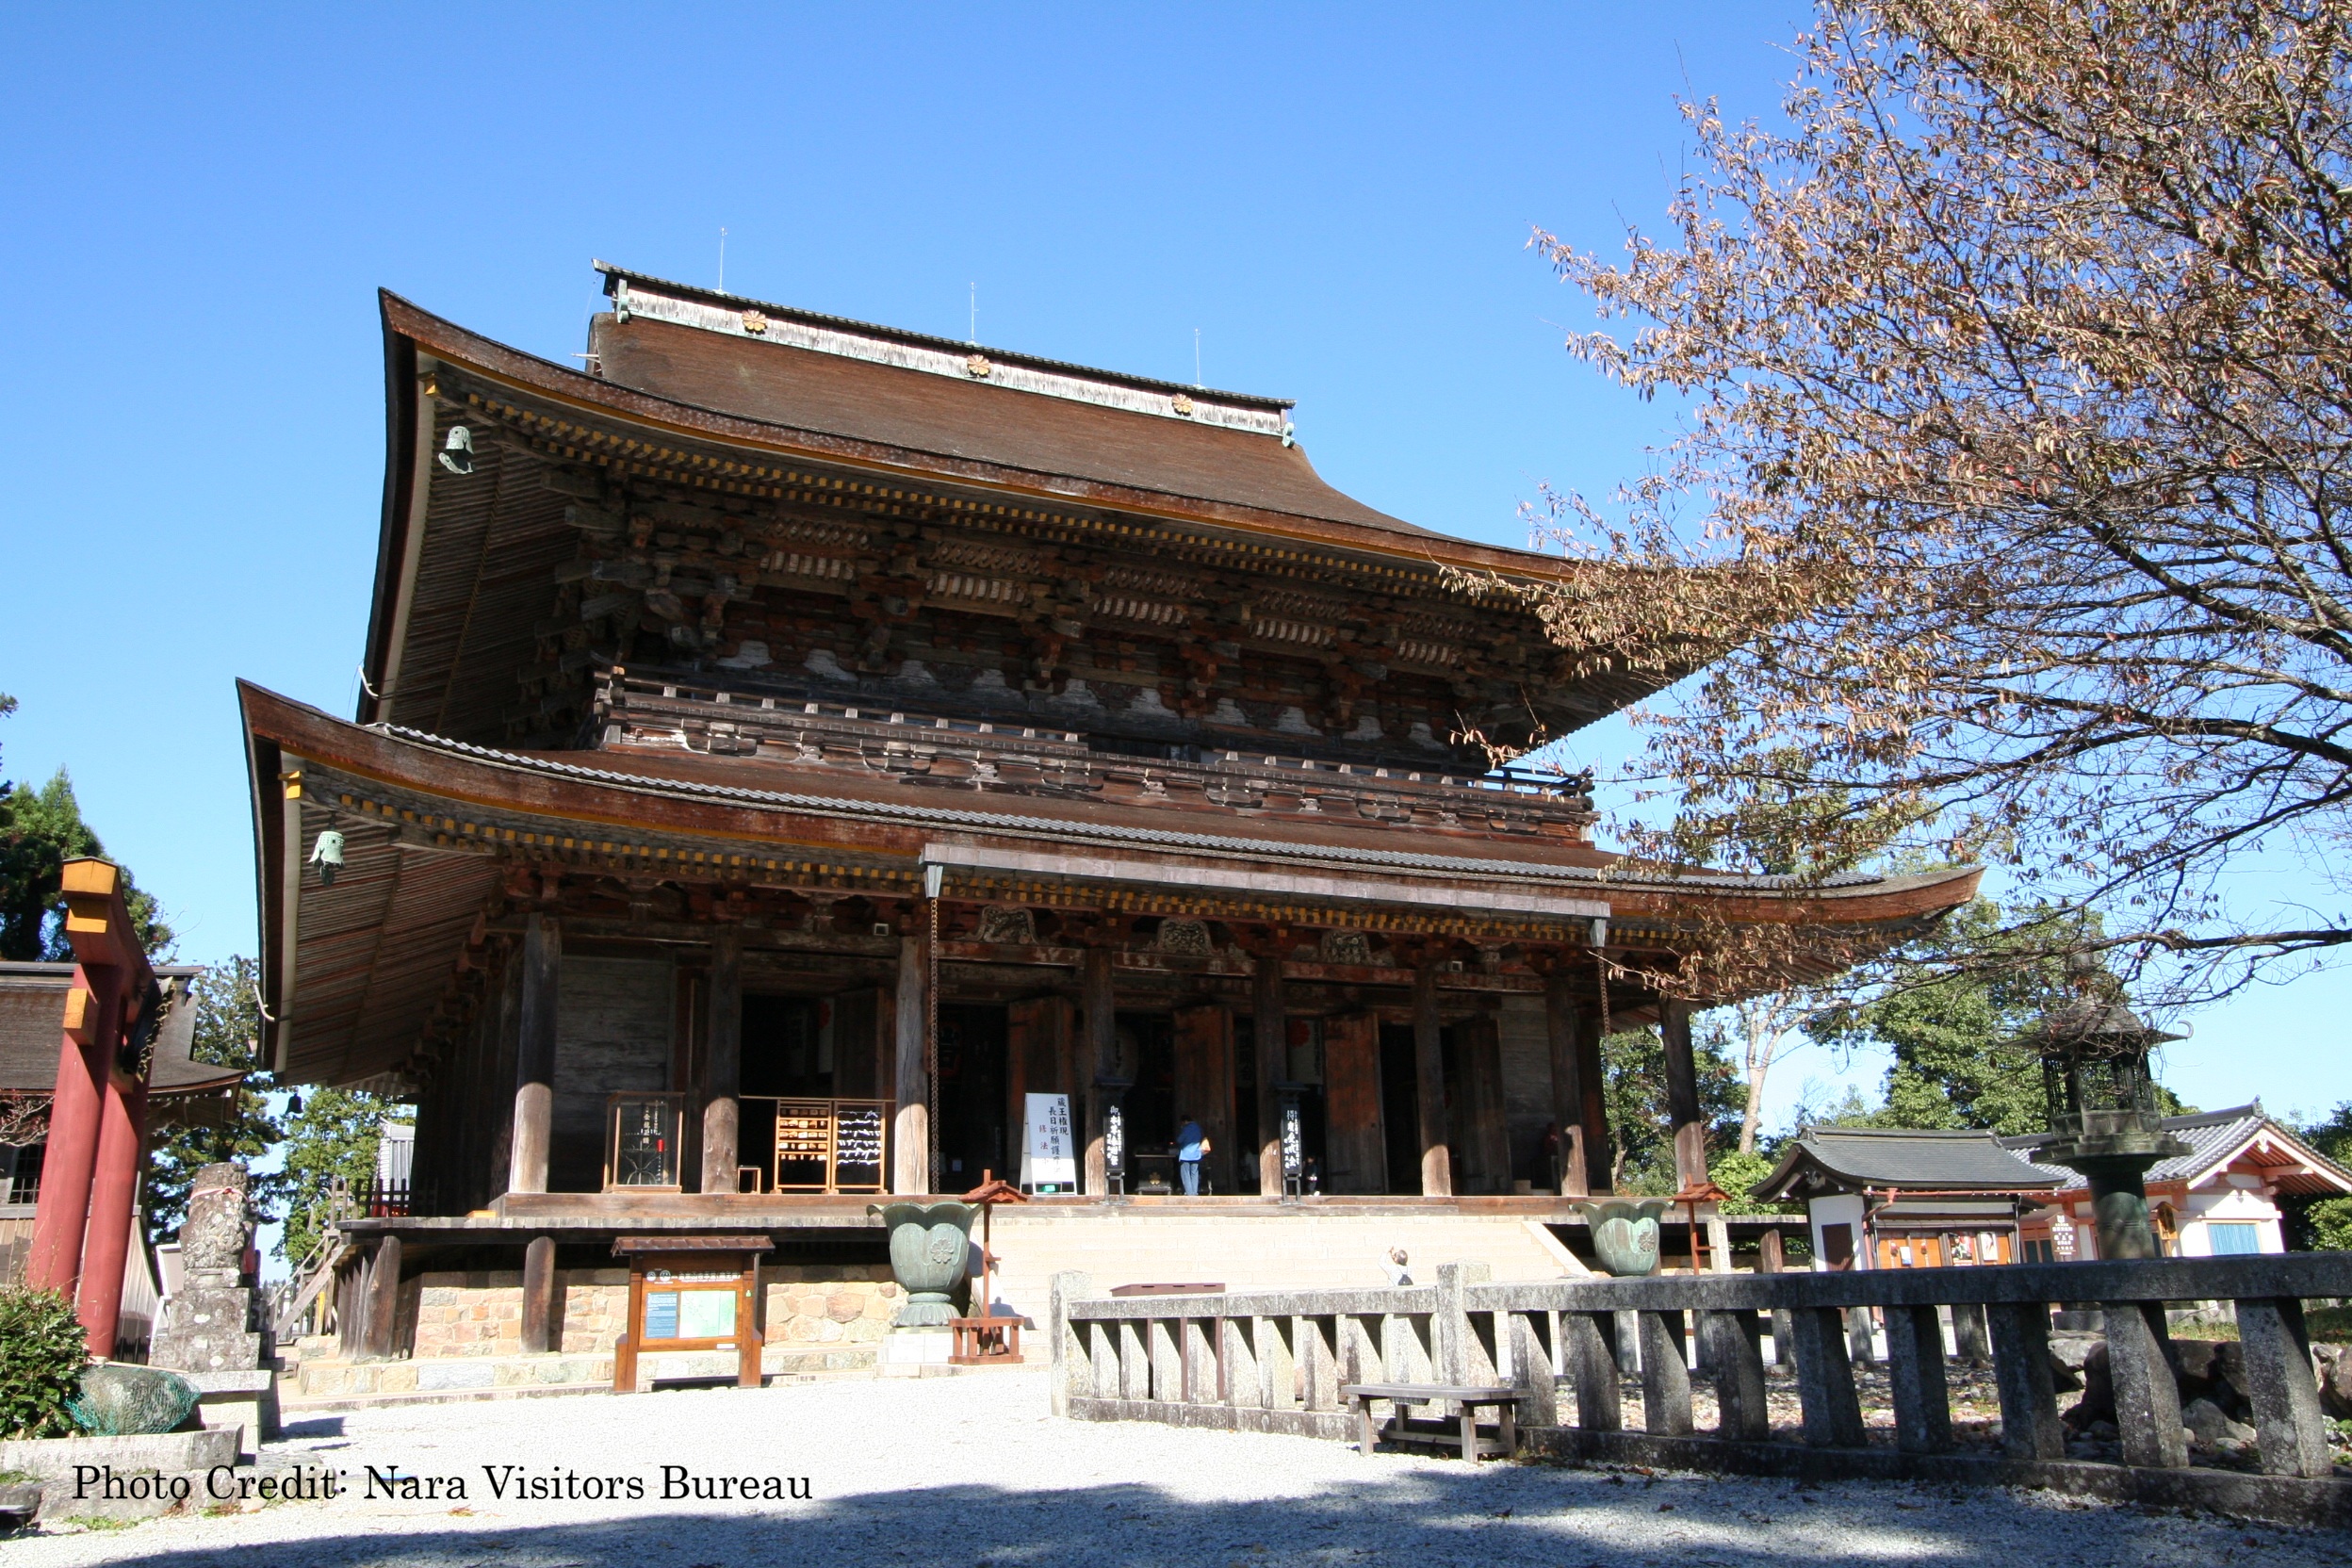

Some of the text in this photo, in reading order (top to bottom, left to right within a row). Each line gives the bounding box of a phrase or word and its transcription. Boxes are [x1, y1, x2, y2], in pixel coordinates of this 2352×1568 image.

[1049, 1106, 1061, 1172] 長日祈願護
[1057, 1097, 1069, 1135] 蔵王権現
